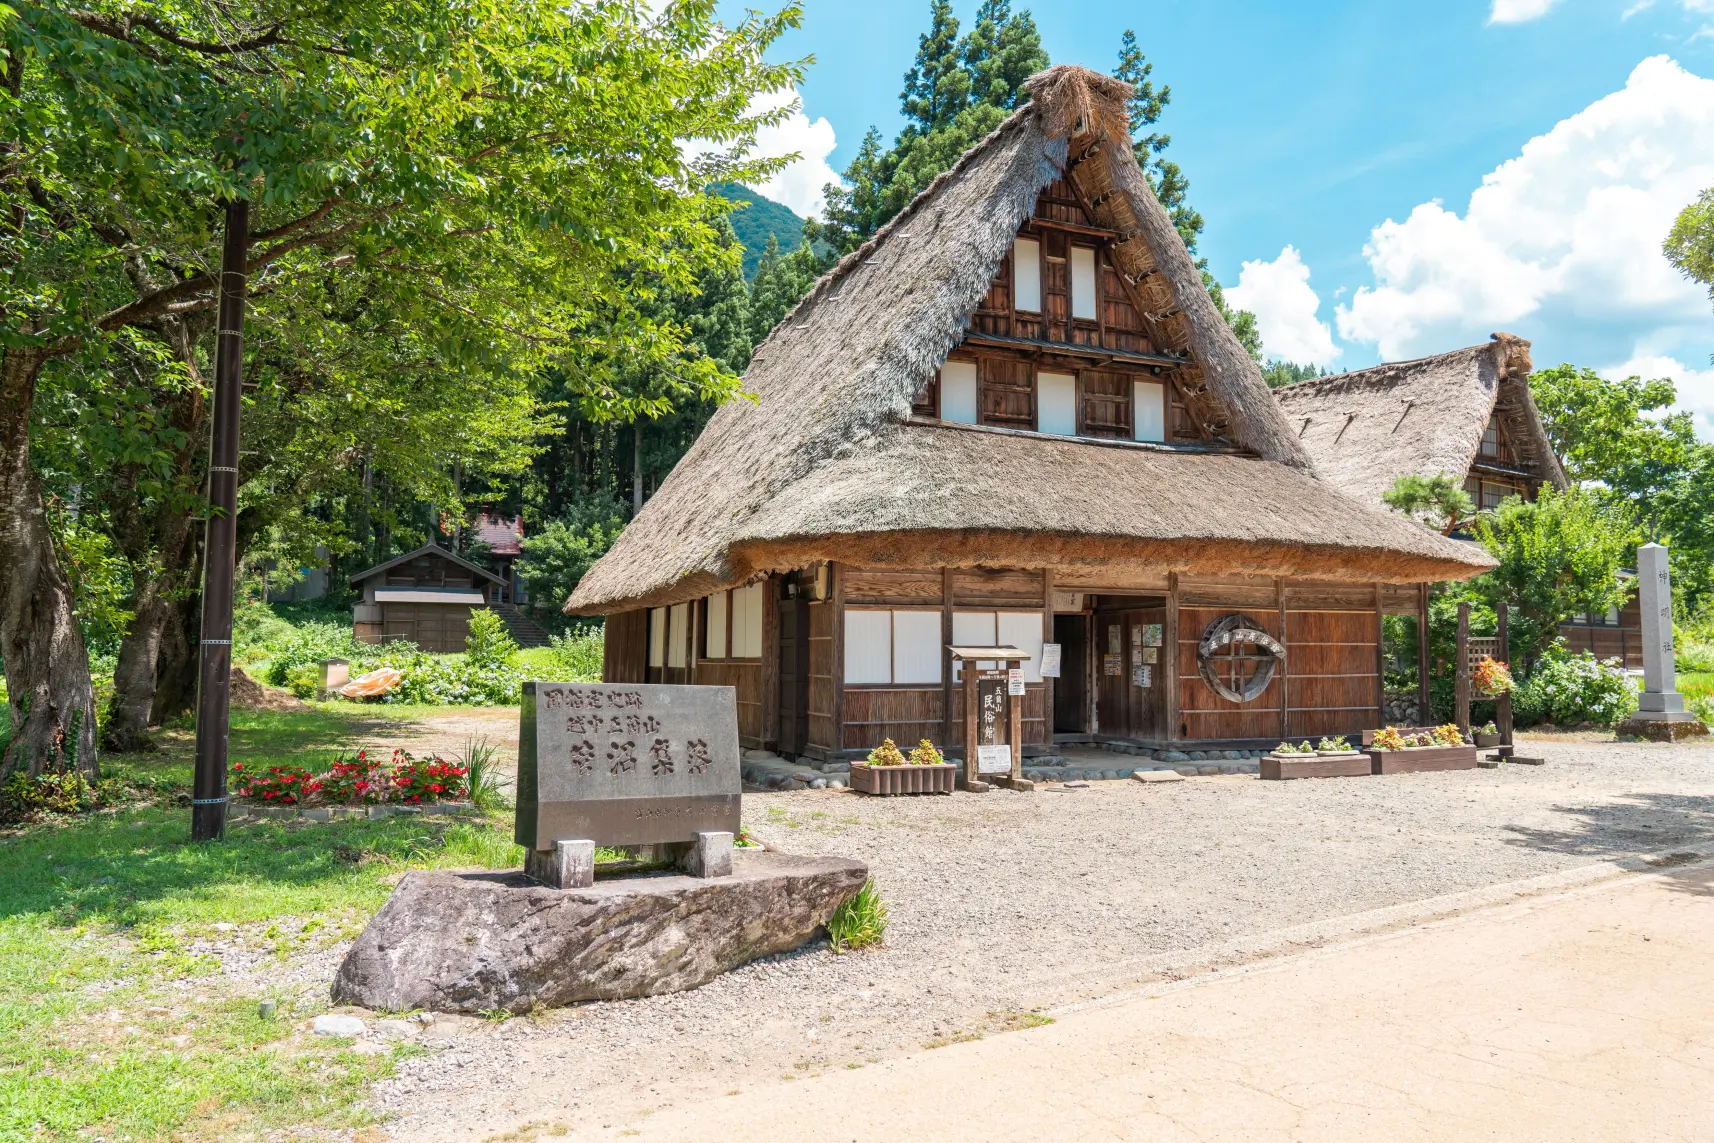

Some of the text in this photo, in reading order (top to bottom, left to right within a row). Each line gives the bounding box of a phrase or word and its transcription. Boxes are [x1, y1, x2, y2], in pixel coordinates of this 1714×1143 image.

[1658, 570, 1672, 654] 神明社
[567, 714, 661, 736] 越中五箇山
[984, 694, 995, 740] 民俗館
[570, 738, 713, 777] 菅沼集落
